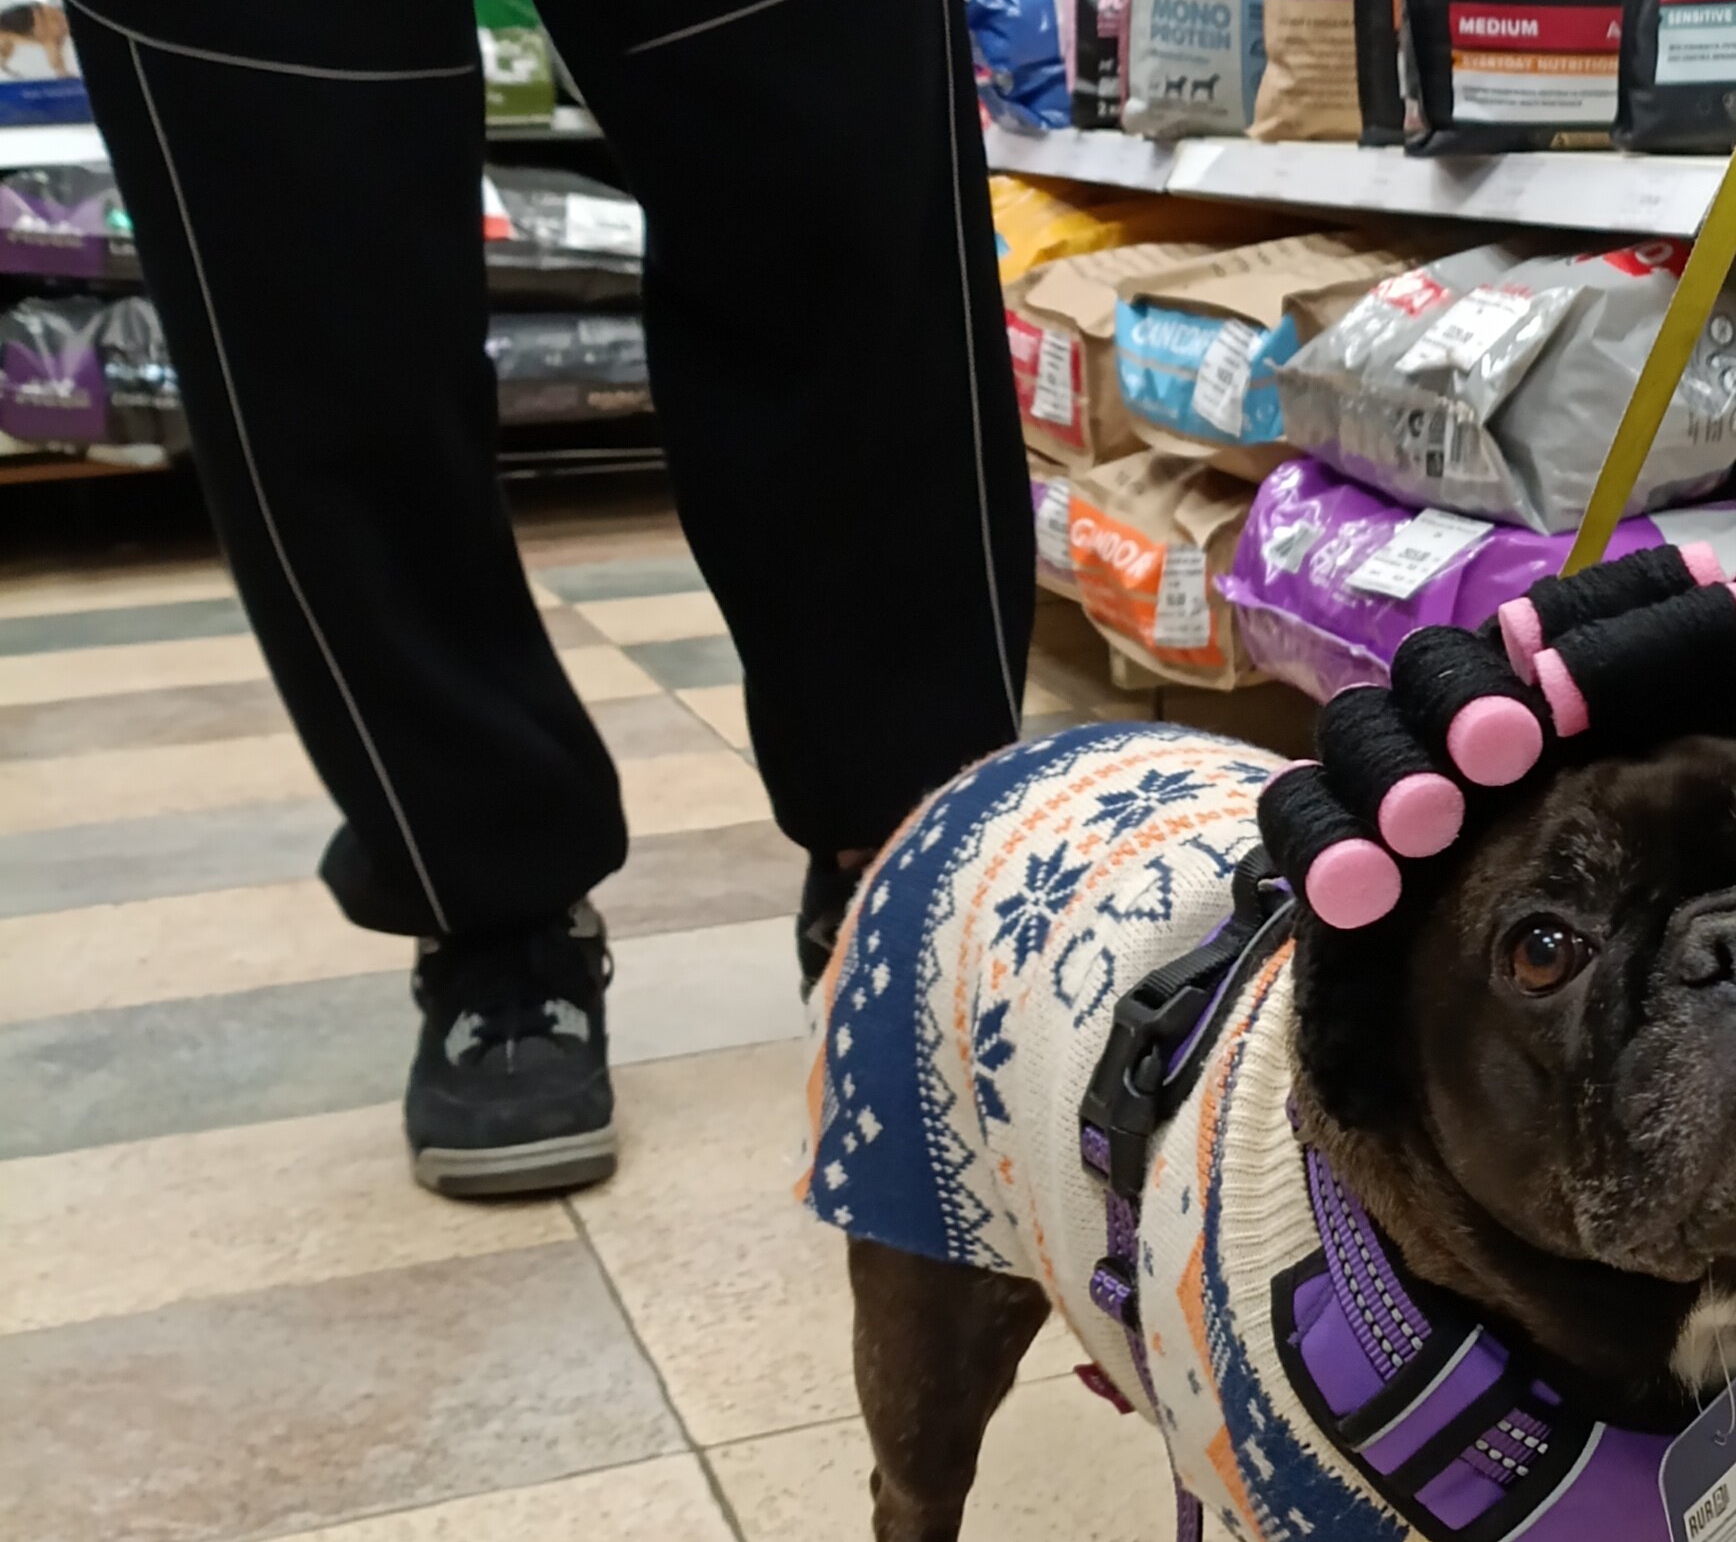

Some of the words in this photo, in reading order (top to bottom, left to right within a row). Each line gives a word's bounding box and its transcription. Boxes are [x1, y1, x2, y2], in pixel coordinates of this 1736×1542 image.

[1458, 16, 1539, 38] MEDIUM
[1668, 5, 1733, 27] SENSITIVE
[1152, 22, 1232, 51] PROTEIN
